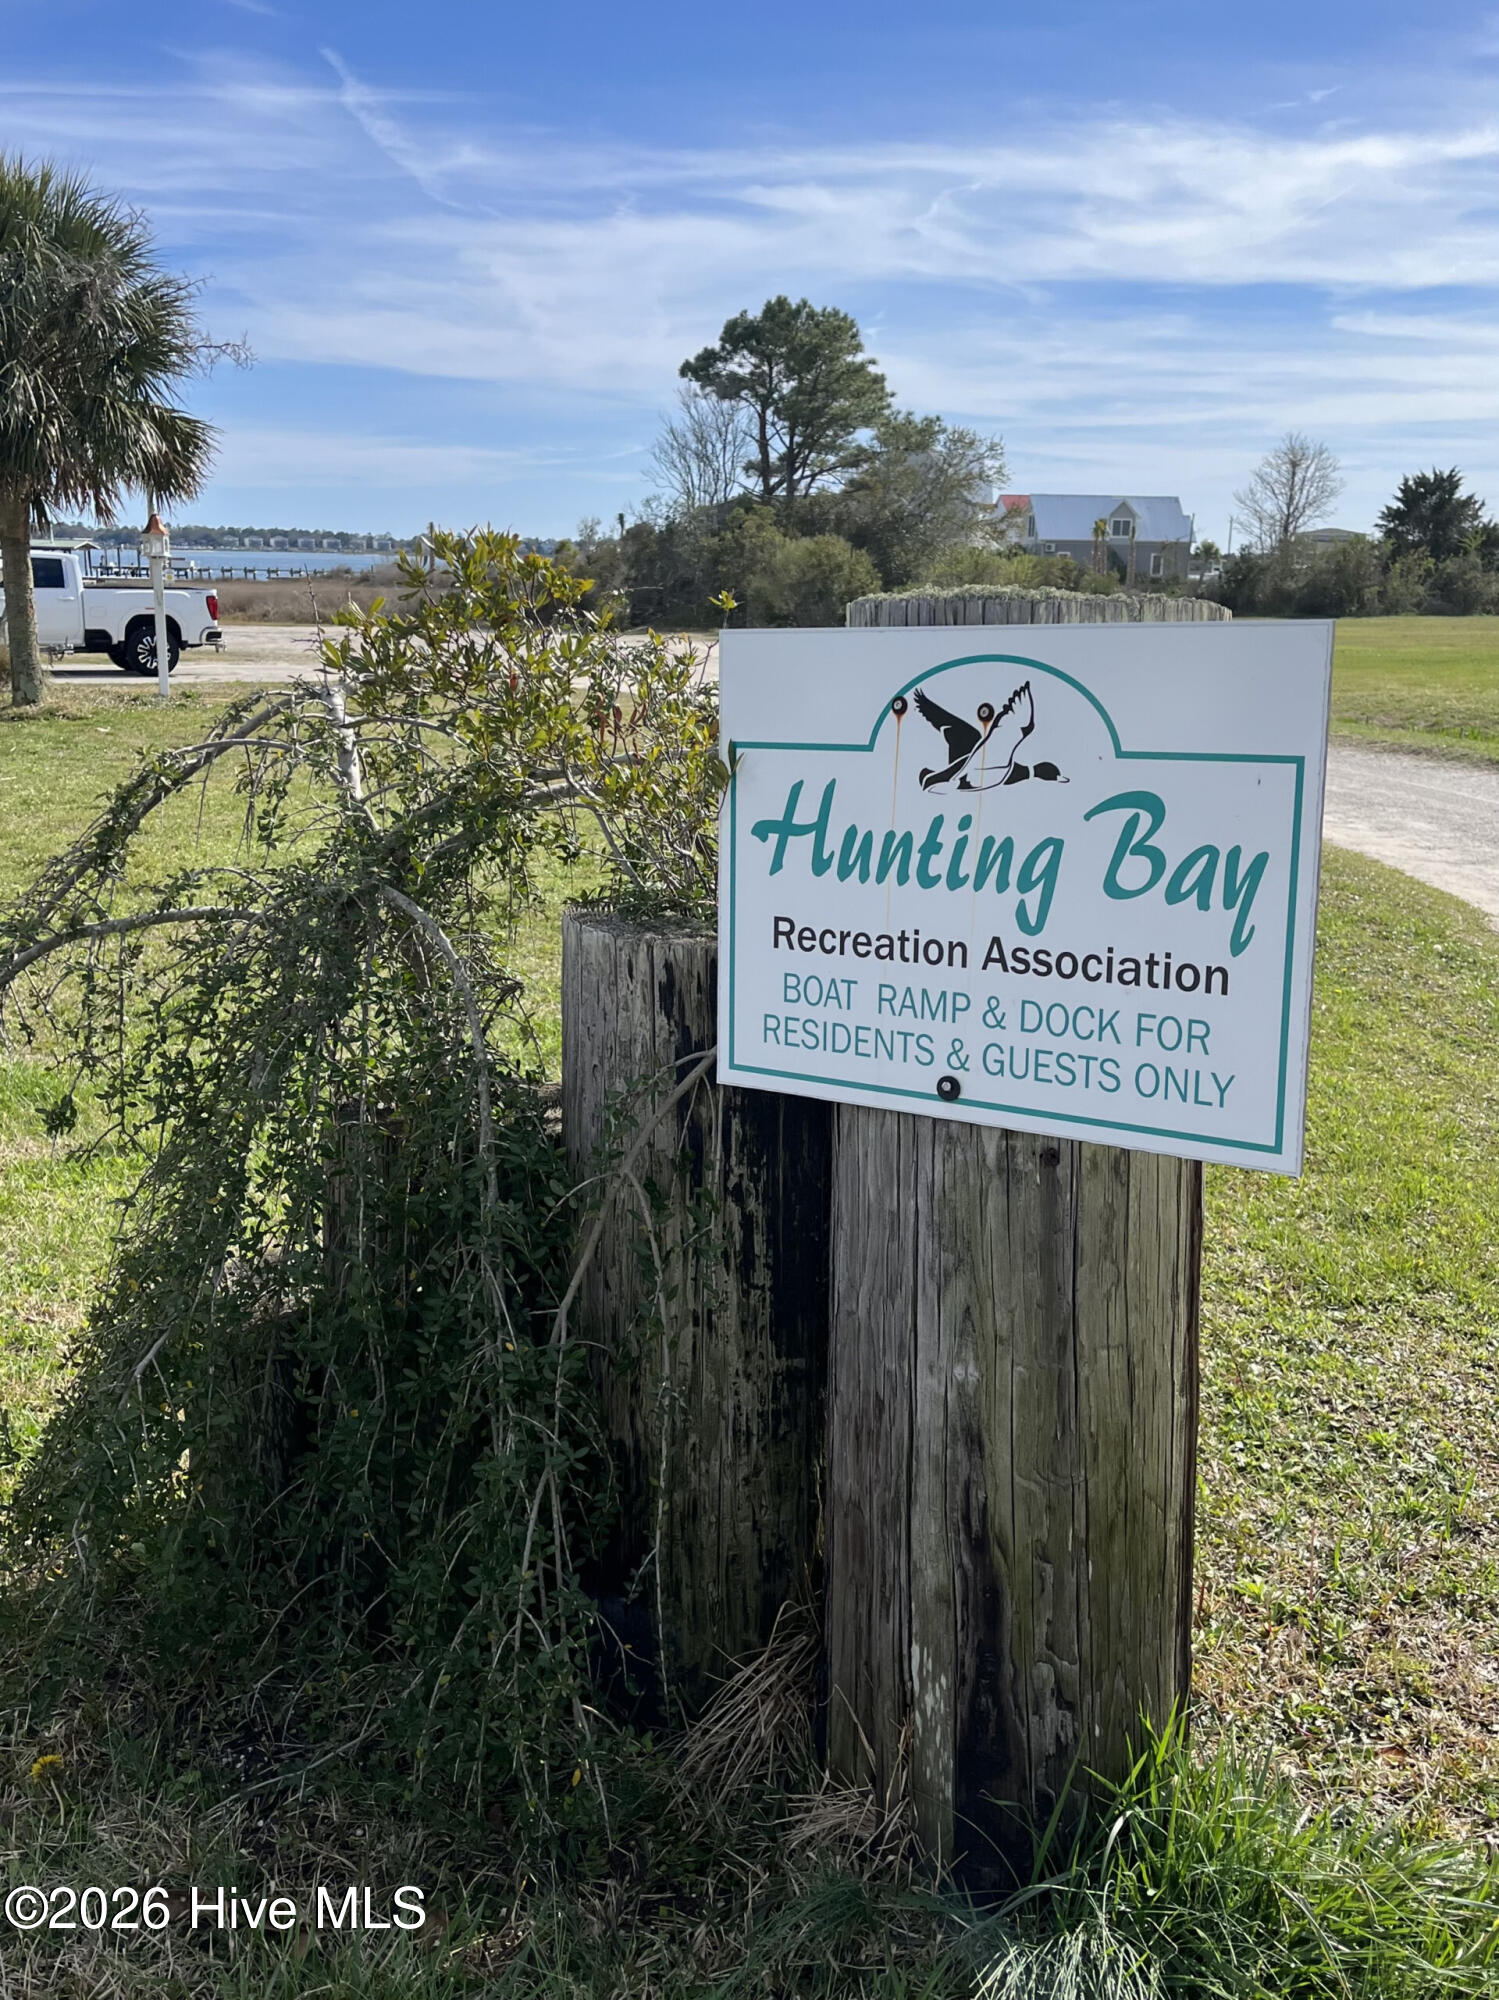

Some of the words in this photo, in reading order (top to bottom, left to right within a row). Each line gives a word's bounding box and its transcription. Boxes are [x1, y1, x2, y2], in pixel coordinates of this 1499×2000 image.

[751, 778, 1065, 937] Hunting
[1083, 790, 1270, 959] Bay
[773, 915, 968, 969] Recreation
[982, 936, 1230, 996] Association
[783, 972, 858, 1010] BOAT
[878, 983, 971, 1024] RAMP
[982, 995, 1007, 1030] &
[1020, 999, 1122, 1045] DOCK
[1136, 1012, 1210, 1055] FOR
[763, 1013, 935, 1066] RESIDENTS
[946, 1037, 971, 1072] &
[982, 1042, 1121, 1093] GUESTS
[1135, 1062, 1236, 1108] ONLY
